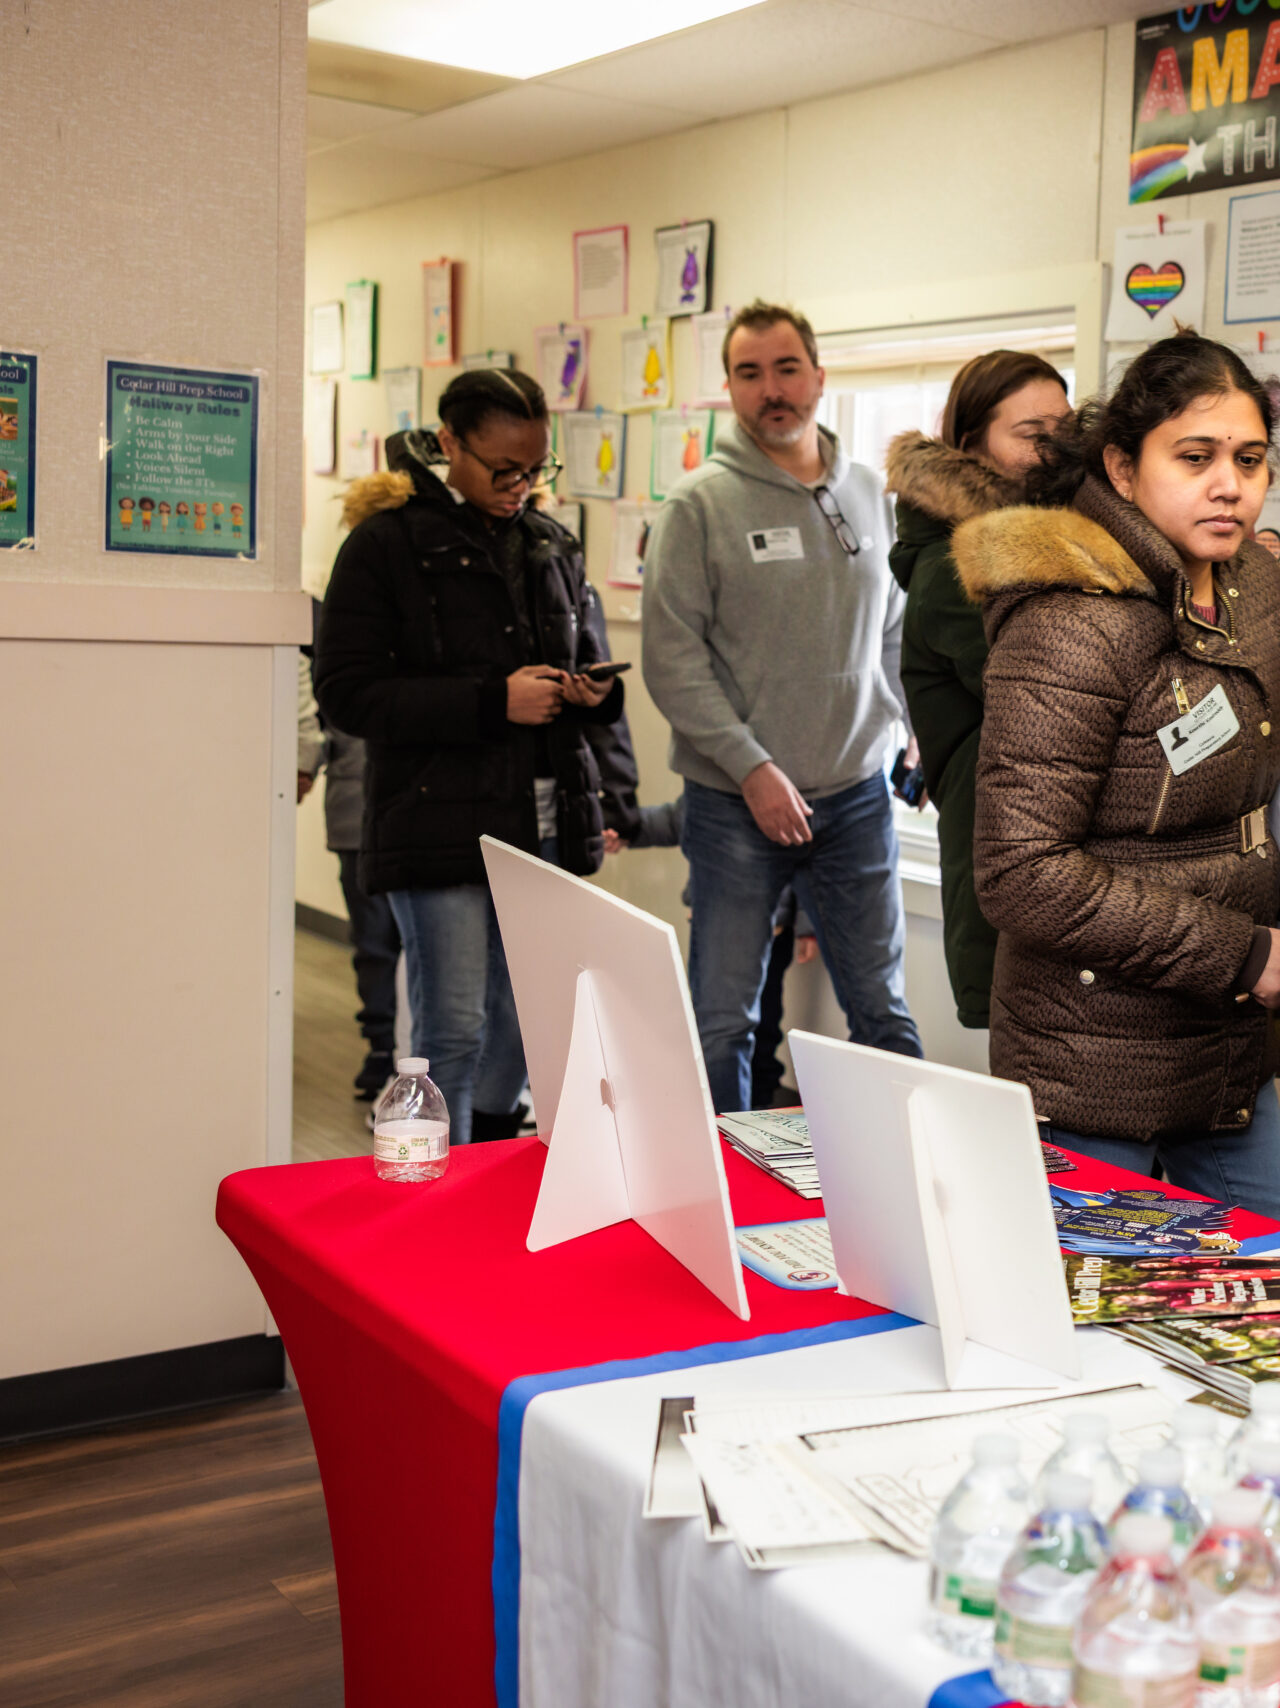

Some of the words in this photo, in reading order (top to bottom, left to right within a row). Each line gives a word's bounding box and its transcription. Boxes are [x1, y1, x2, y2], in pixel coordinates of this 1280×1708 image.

[120, 377, 152, 391] Cedar
[155, 380, 176, 393] Hill
[179, 384, 204, 397] Prep
[207, 386, 243, 400] School
[130, 395, 194, 416] Hallway
[197, 403, 241, 417] Rules
[135, 415, 150, 425] Be
[152, 416, 183, 429] Calm
[135, 426, 166, 438] Arms
[168, 428, 182, 441] by
[184, 432, 211, 443] your
[213, 433, 238, 445] Side
[135, 438, 164, 450] Walk
[167, 442, 182, 451] on
[185, 442, 202, 453] the
[205, 443, 234, 457] Right
[135, 450, 163, 461] Look
[166, 452, 202, 465] Ahead
[134, 461, 171, 474] Voices
[173, 464, 206, 476] Silent
[134, 472, 172, 485] Follow
[175, 474, 193, 486] the
[1193, 697, 1215, 718] VISITOR
[1076, 1256, 1111, 1277] Prep
[1070, 1289, 1100, 1315] Cedar
